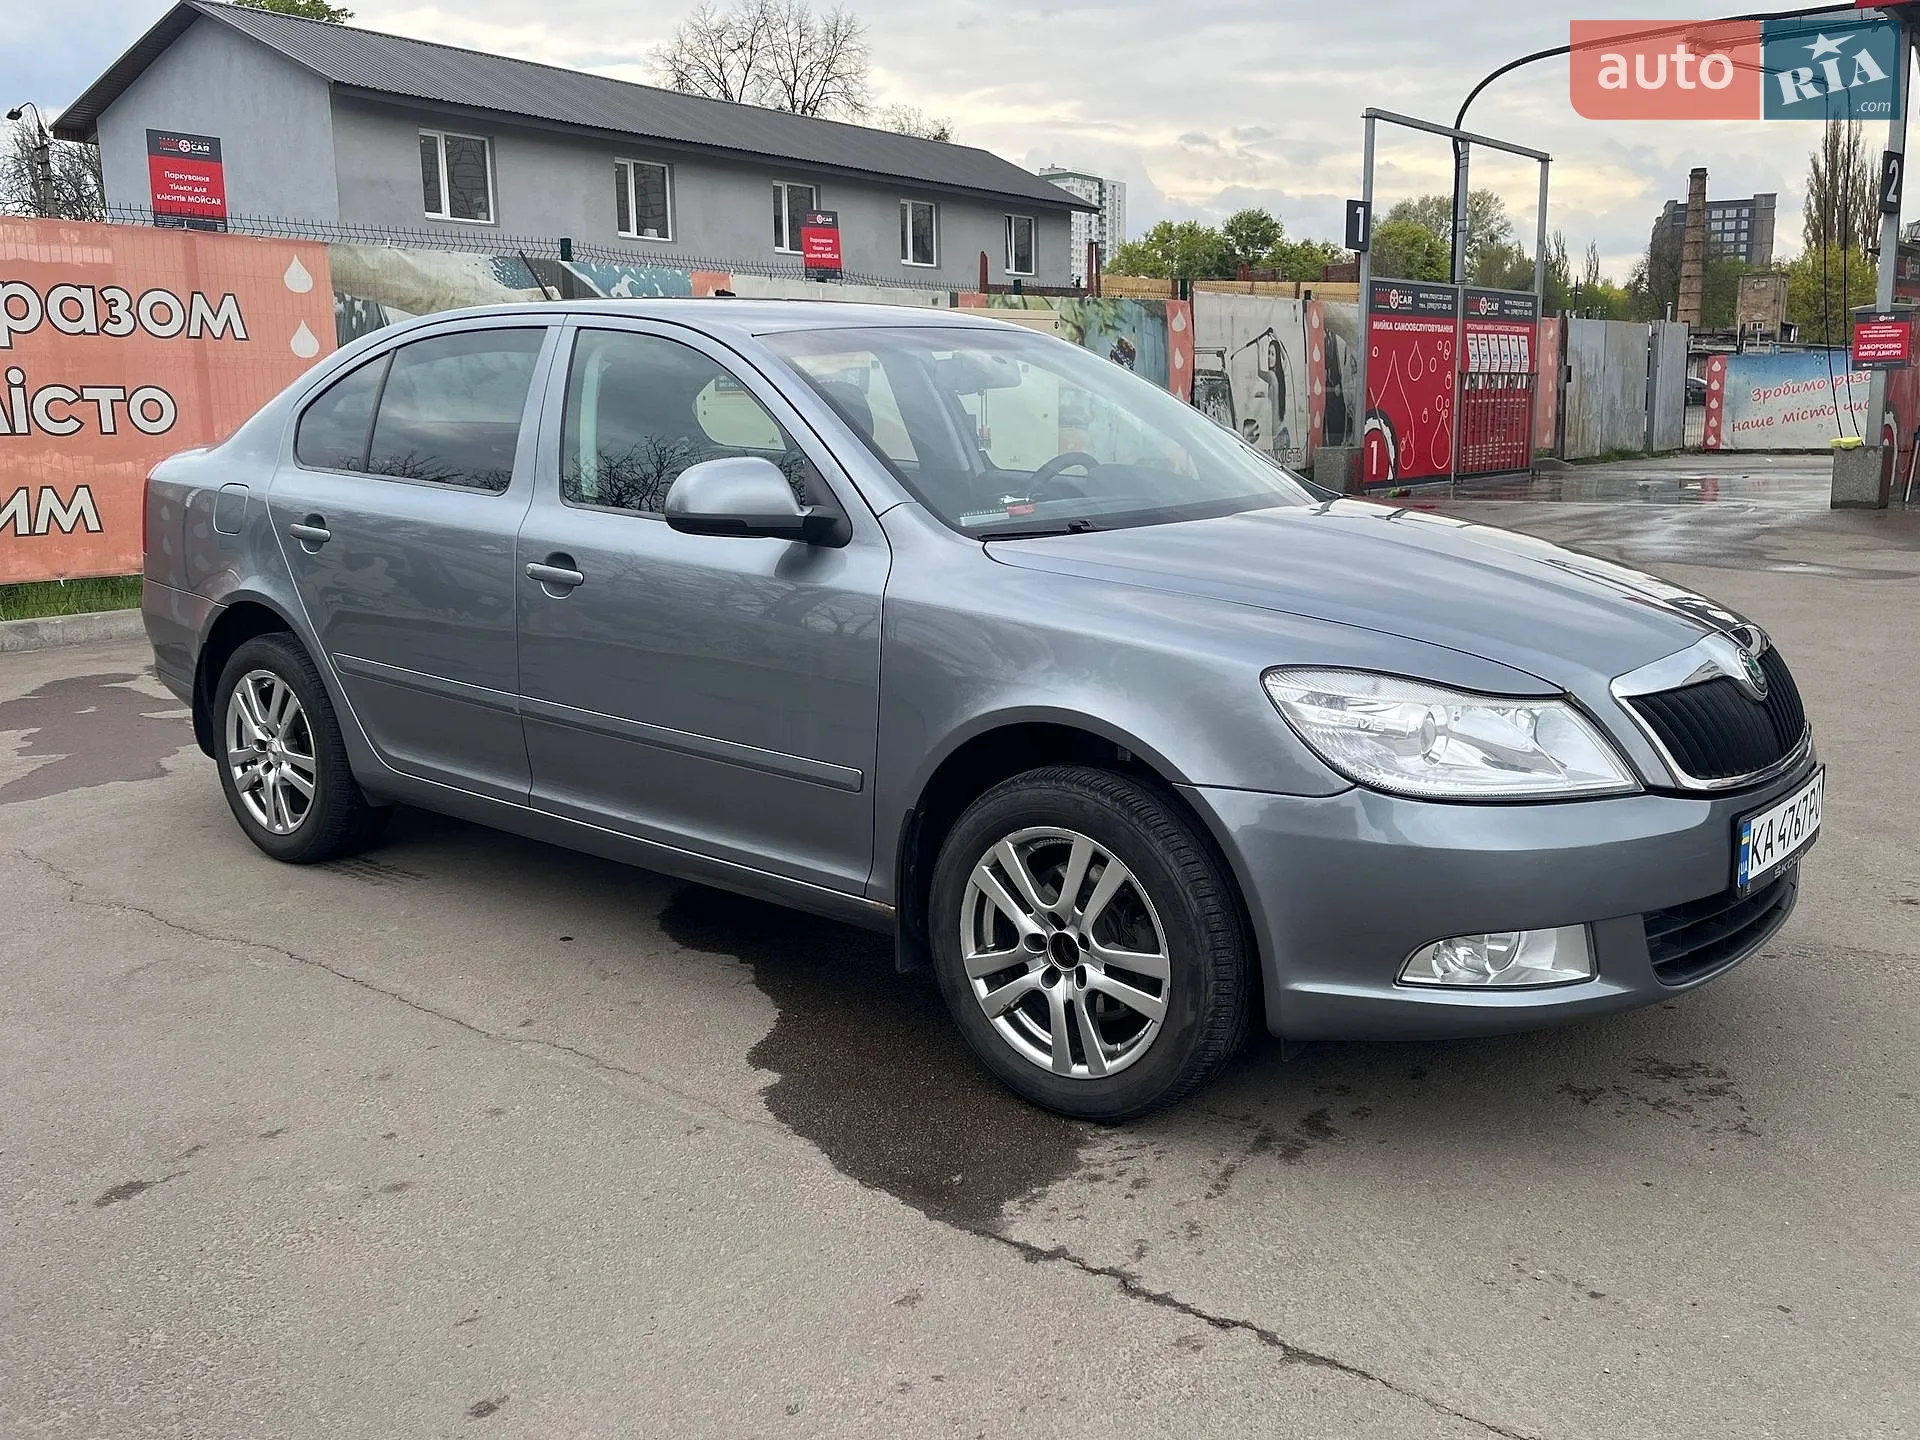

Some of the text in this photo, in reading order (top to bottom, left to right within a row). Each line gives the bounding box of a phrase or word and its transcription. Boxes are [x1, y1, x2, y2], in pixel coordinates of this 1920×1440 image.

[164, 171, 210, 182] Паркування
[169, 183, 193, 192] тільки
[1886, 159, 1898, 203] 2
[156, 193, 186, 202] клієнтів
[1355, 206, 1364, 242] 1
[0, 280, 249, 349] разом
[1398, 295, 1412, 305] CAR
[1372, 320, 1393, 331] МИЙКА
[0, 366, 178, 436] істо
[1751, 378, 1827, 404] Зробимо
[1731, 415, 1775, 433] наше
[1781, 404, 1835, 425] місто
[1370, 440, 1377, 475] 1
[1750, 818, 1774, 871] KA
[1778, 794, 1808, 851] 4767
